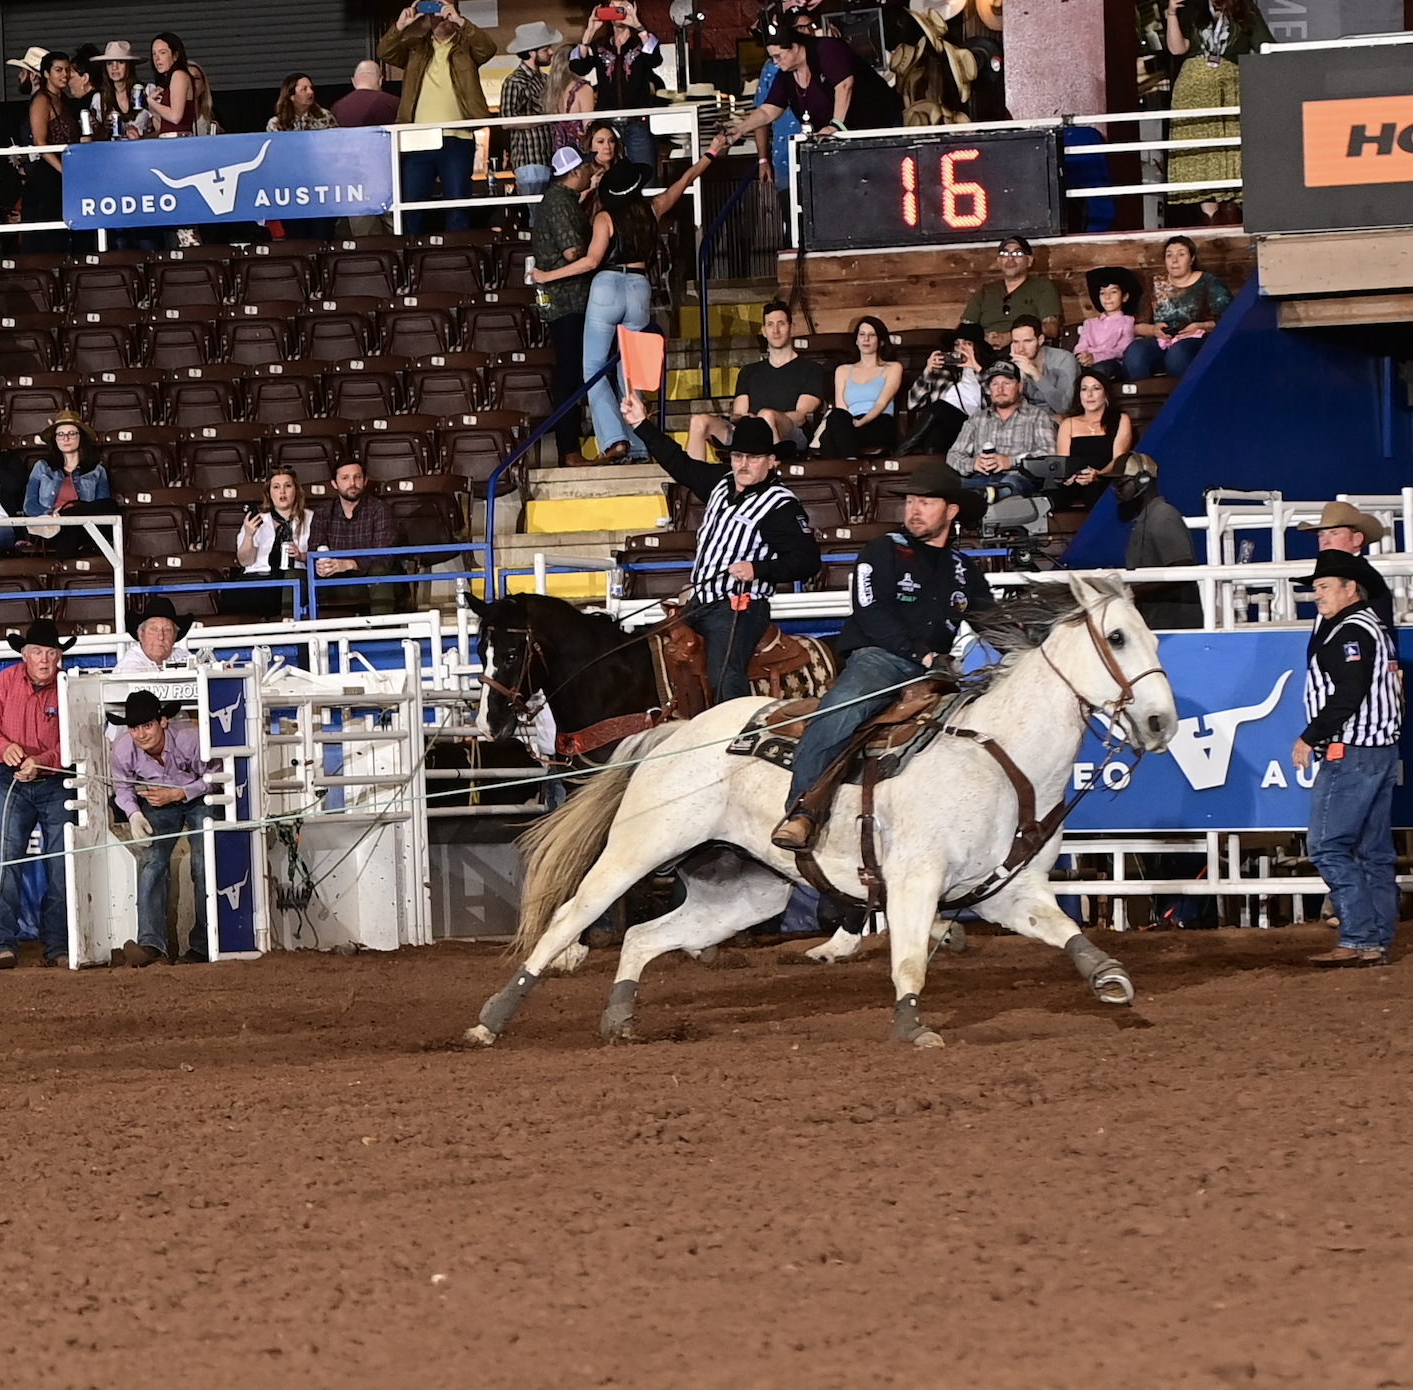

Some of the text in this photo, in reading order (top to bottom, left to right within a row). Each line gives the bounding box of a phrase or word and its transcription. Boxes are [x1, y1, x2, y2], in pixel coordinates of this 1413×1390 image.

[81, 184, 364, 216] RODEO AUSTIN
[901, 149, 987, 228] 16
